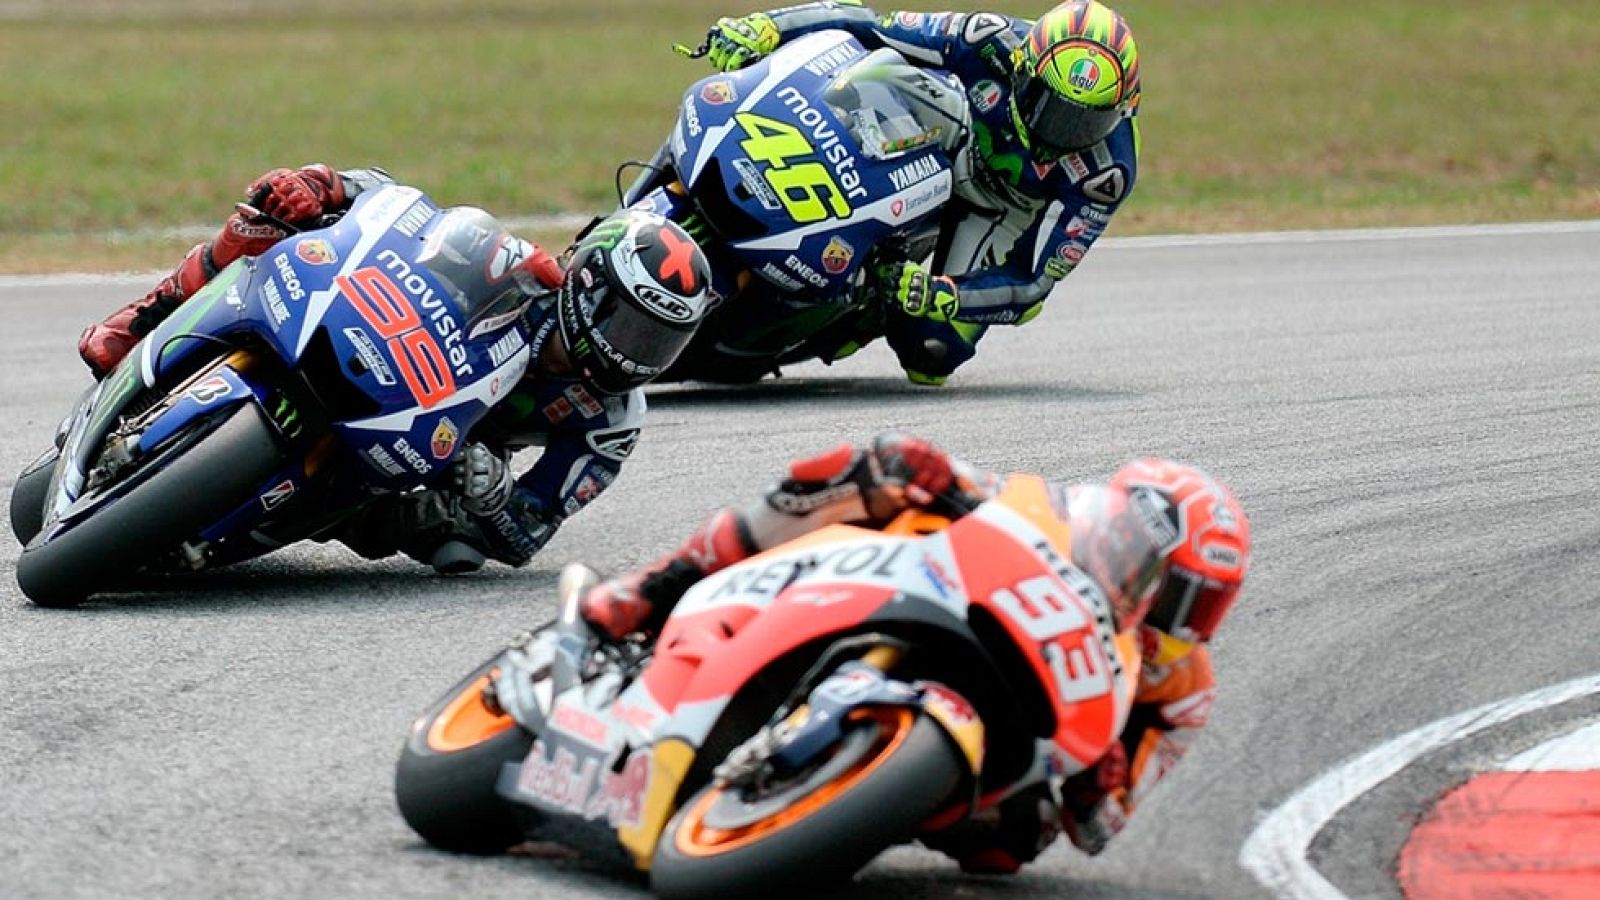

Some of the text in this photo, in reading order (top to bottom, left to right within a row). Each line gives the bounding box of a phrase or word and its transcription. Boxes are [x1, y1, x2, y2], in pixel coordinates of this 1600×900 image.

[734, 111, 851, 224] 46
[777, 86, 868, 199] movistar
[887, 153, 942, 192] YAMAHA
[273, 252, 306, 302] ENEOS
[640, 287, 688, 318] HJC
[784, 254, 830, 288] ENEOS
[333, 265, 457, 410] 99
[376, 249, 475, 377] movistar
[392, 437, 433, 475] ENEOS
[990, 574, 1114, 705] 93
